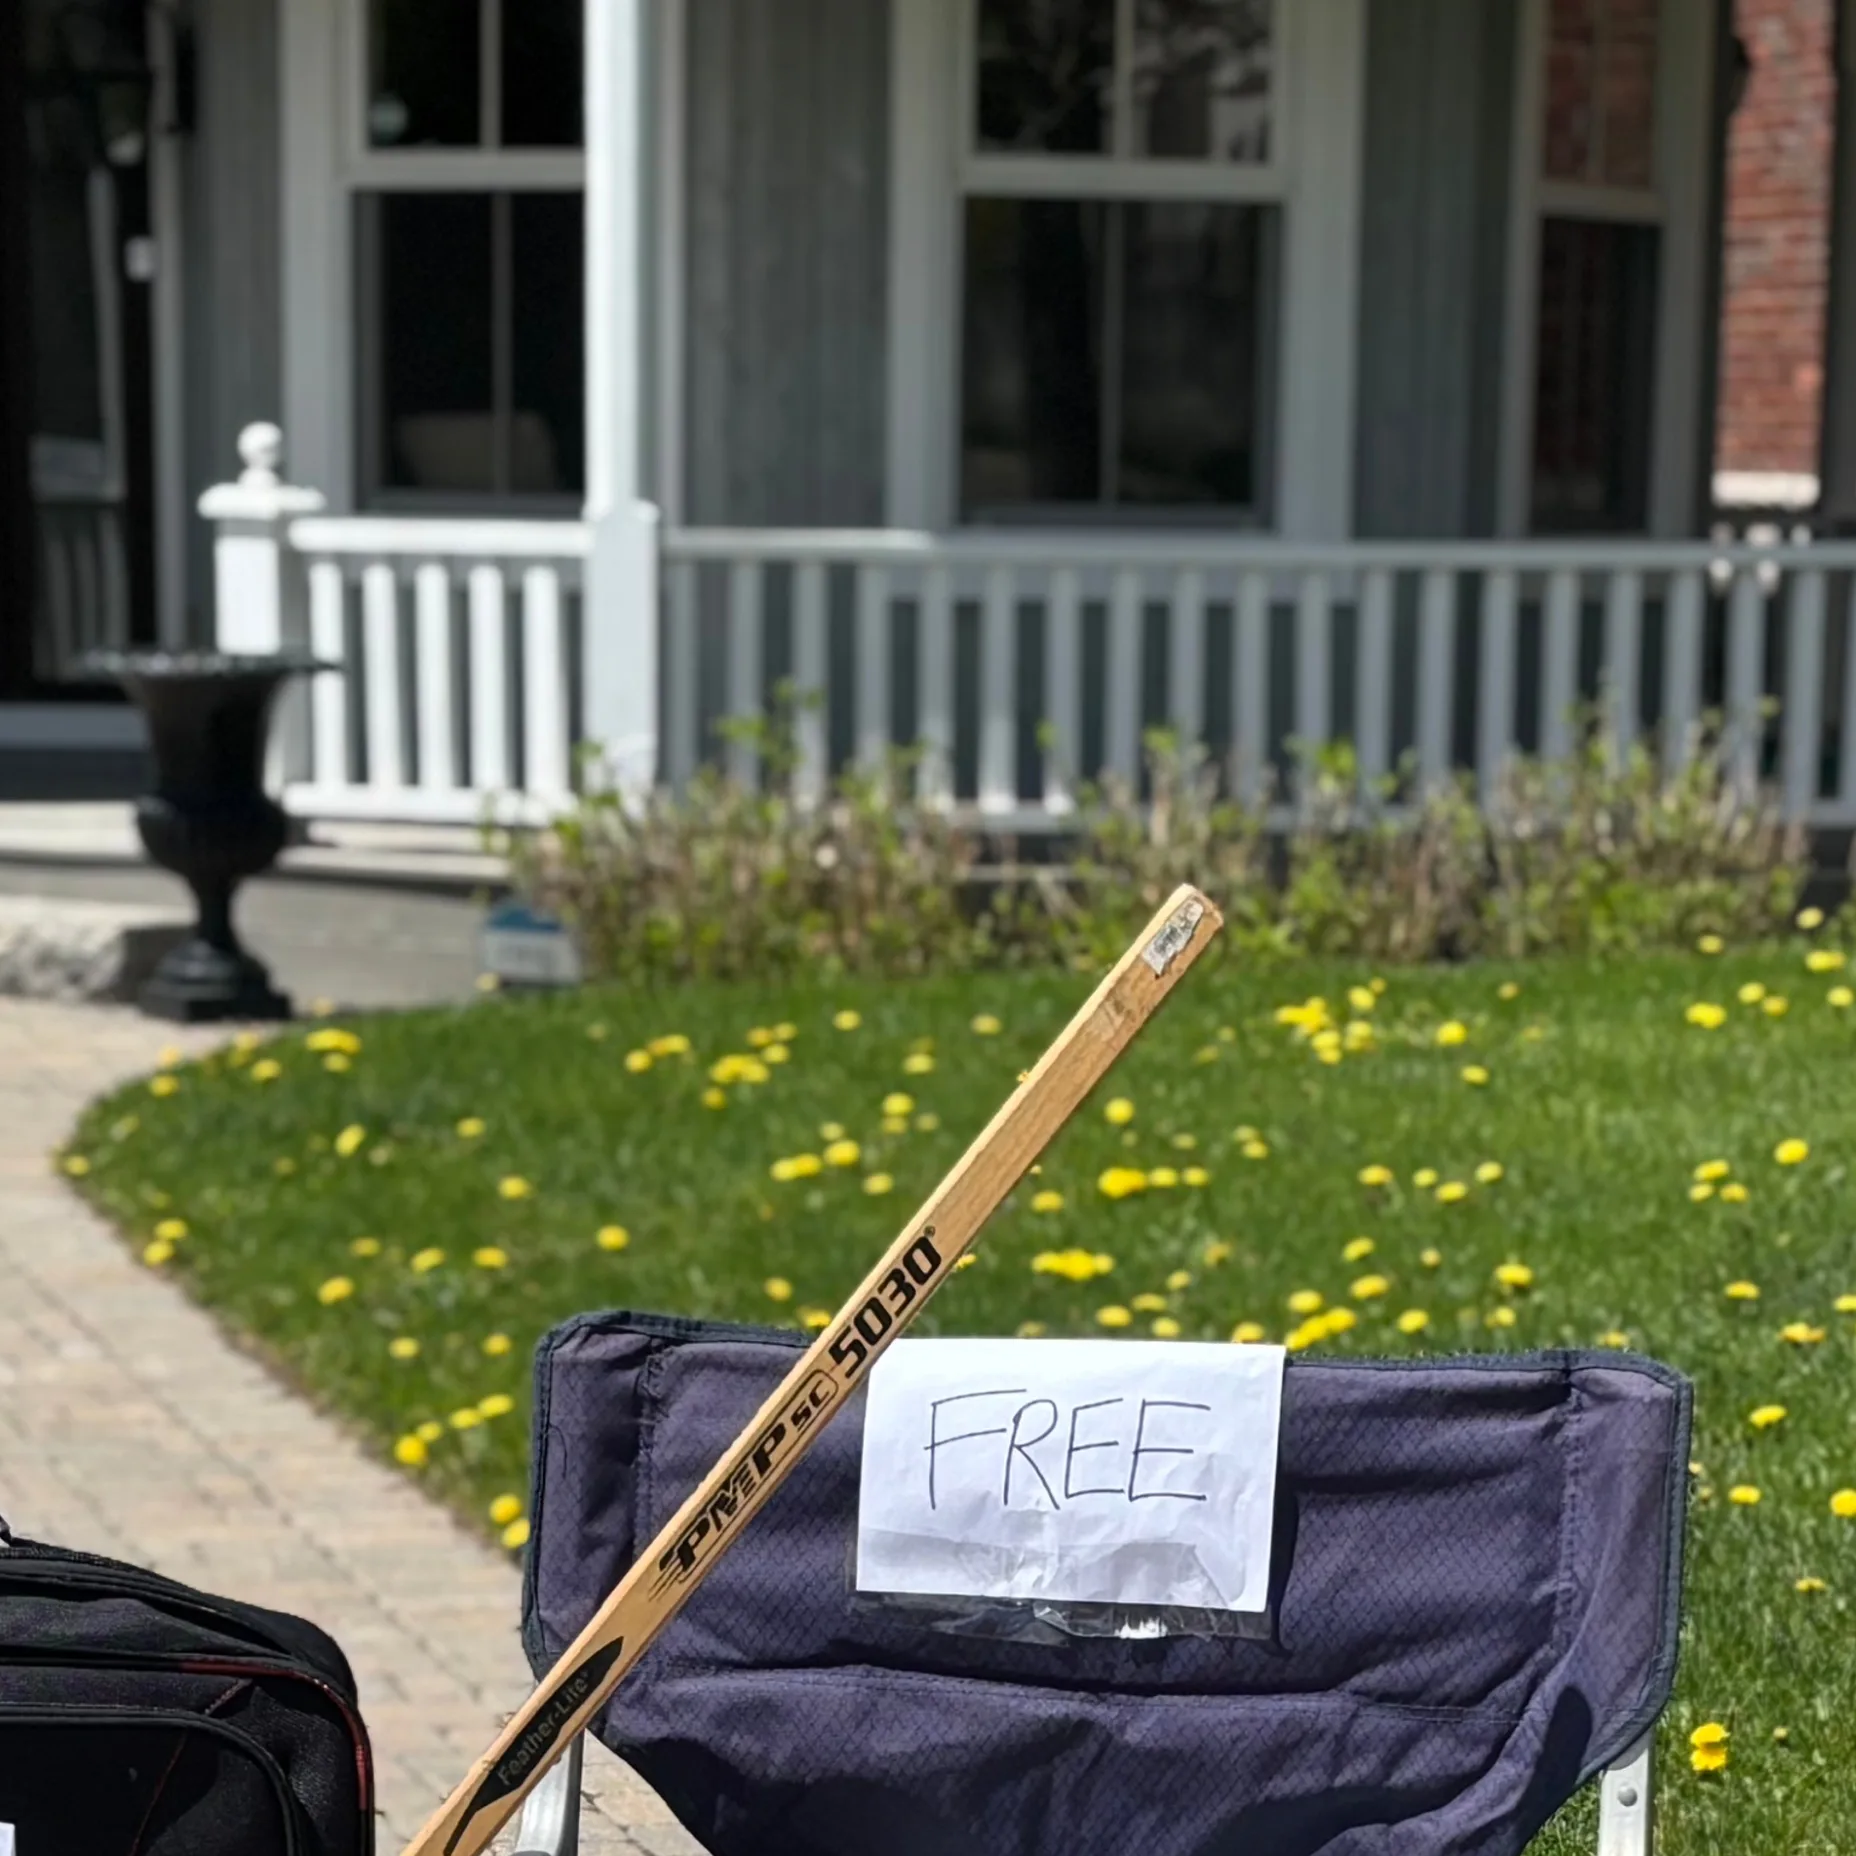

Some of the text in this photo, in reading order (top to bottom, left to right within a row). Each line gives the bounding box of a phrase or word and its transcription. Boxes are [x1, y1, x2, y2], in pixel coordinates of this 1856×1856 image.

[664, 1421, 787, 1573] PMP
[828, 1236, 941, 1379] 5030
[923, 1388, 1211, 1511] FREE
[496, 1676, 588, 1787] Feather-Lite
